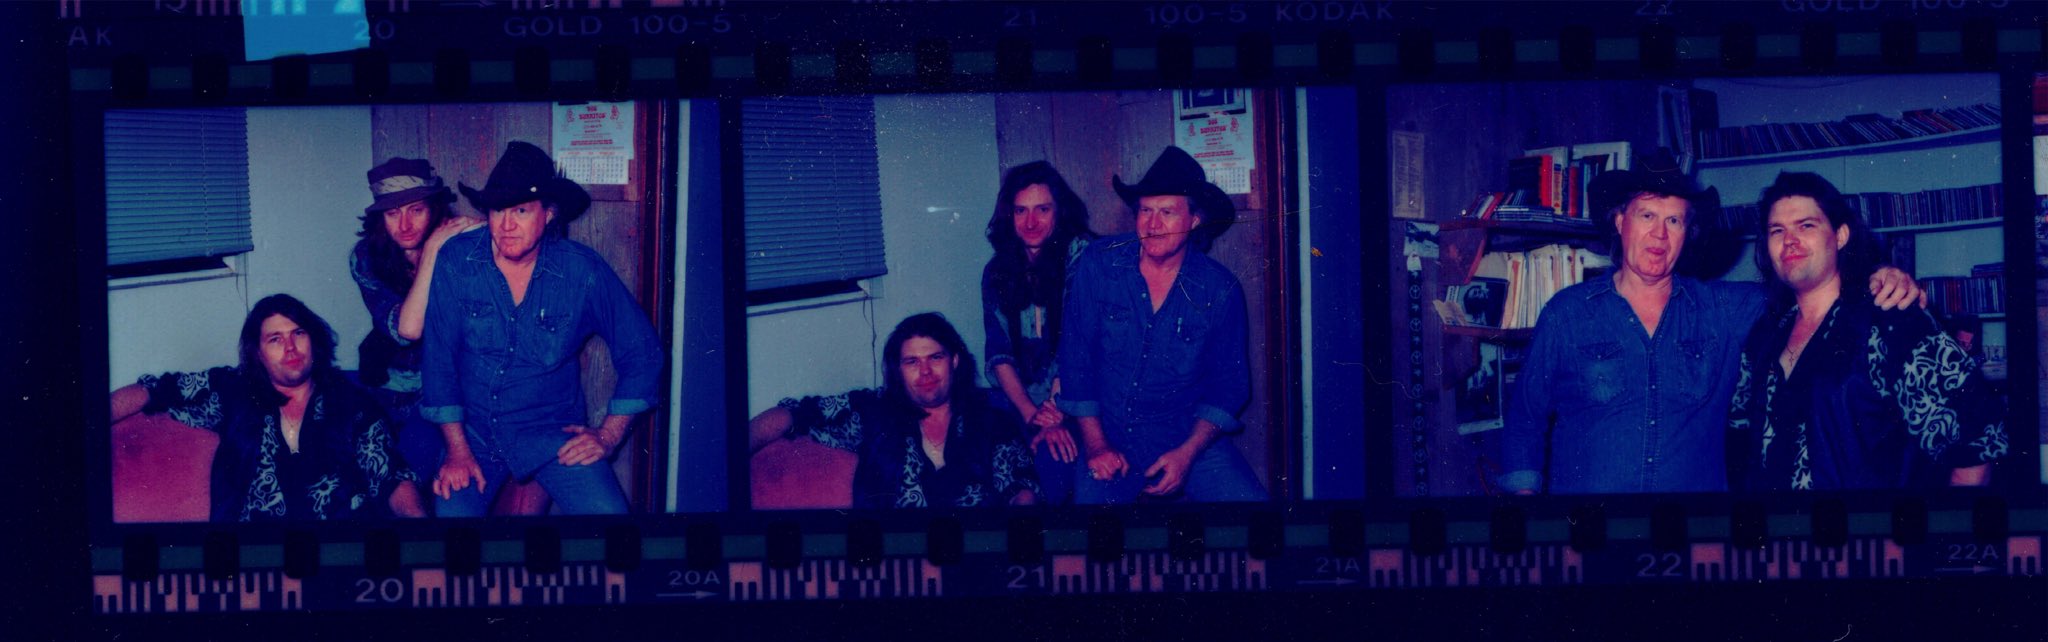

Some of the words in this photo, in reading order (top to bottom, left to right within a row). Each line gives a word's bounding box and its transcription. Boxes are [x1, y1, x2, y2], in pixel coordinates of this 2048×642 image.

[1003, 7, 1036, 27] 21
[1143, 4, 1248, 24] 100-5
[1276, 2, 1394, 22] KODAK
[353, 19, 395, 41] 20
[503, 15, 602, 37] GOLD
[628, 13, 731, 34] 100-5
[1948, 543, 2000, 560] 22A
[1316, 557, 1361, 574] 21A
[1636, 552, 1684, 578] 22
[668, 569, 721, 586] 20A
[1006, 564, 1045, 589] 21
[355, 577, 404, 604] 20
